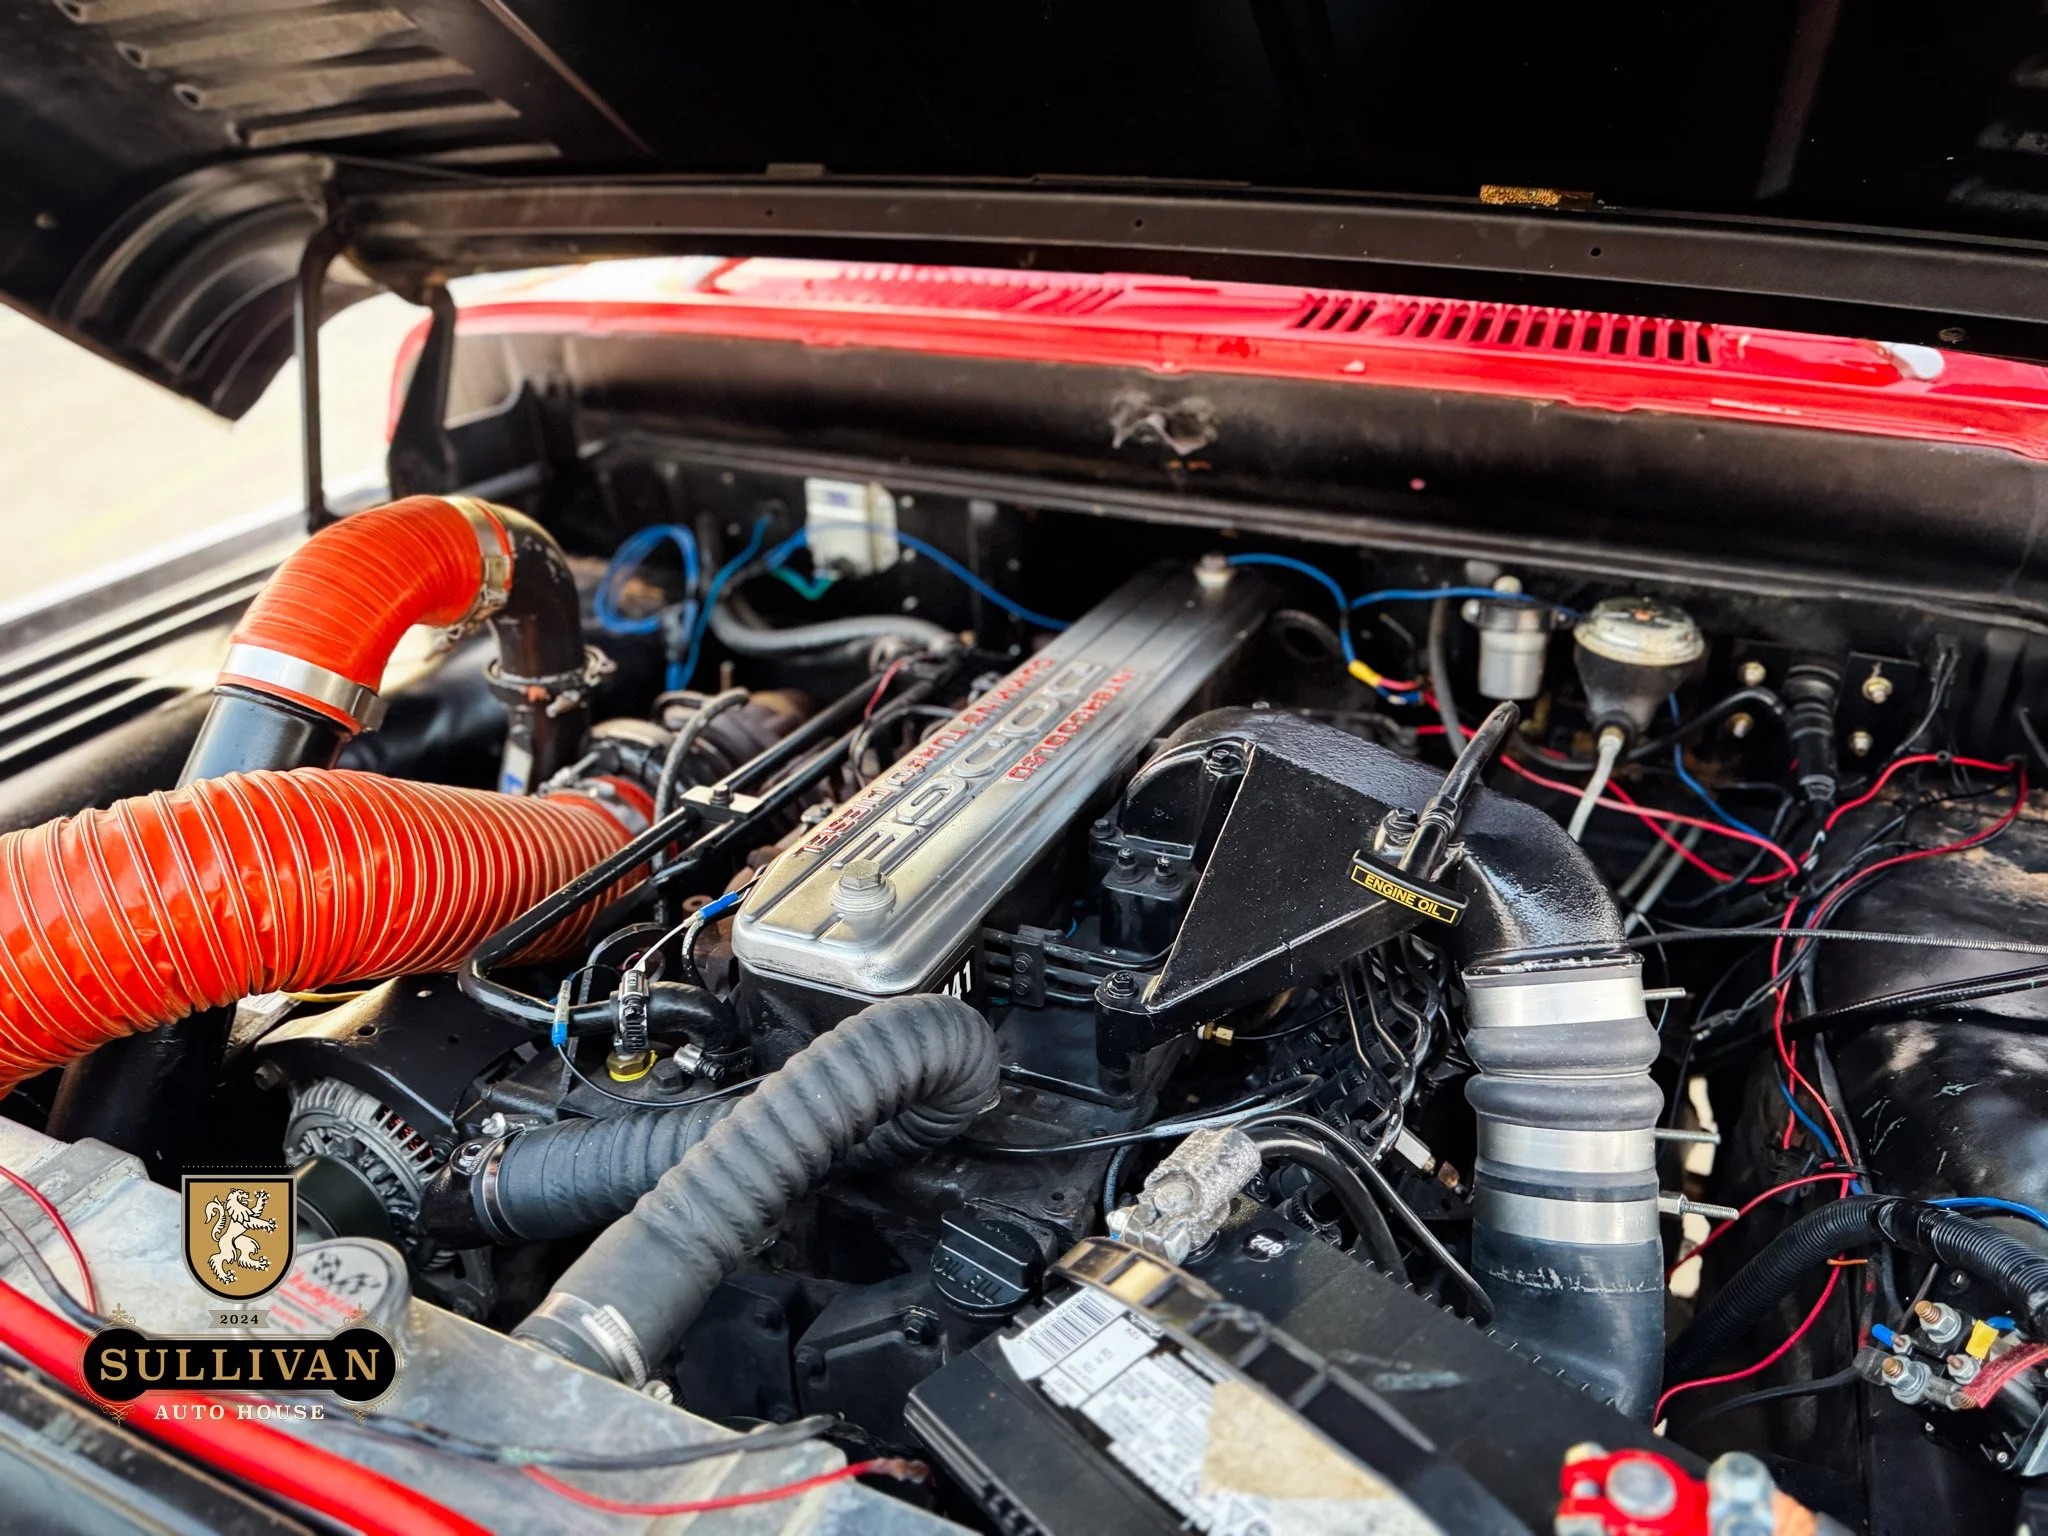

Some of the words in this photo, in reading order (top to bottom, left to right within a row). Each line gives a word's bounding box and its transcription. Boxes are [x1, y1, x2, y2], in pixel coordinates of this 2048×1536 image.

[961, 656, 1055, 726] CUMMINS
[1006, 667, 1136, 782] INTERCOOLED
[831, 661, 1105, 868] DODGE
[884, 726, 970, 787] TURBO
[794, 785, 895, 858] DIESEL
[1364, 873, 1417, 906] ENGINE
[1417, 898, 1440, 916] OIL
[942, 960, 971, 1000] 41
